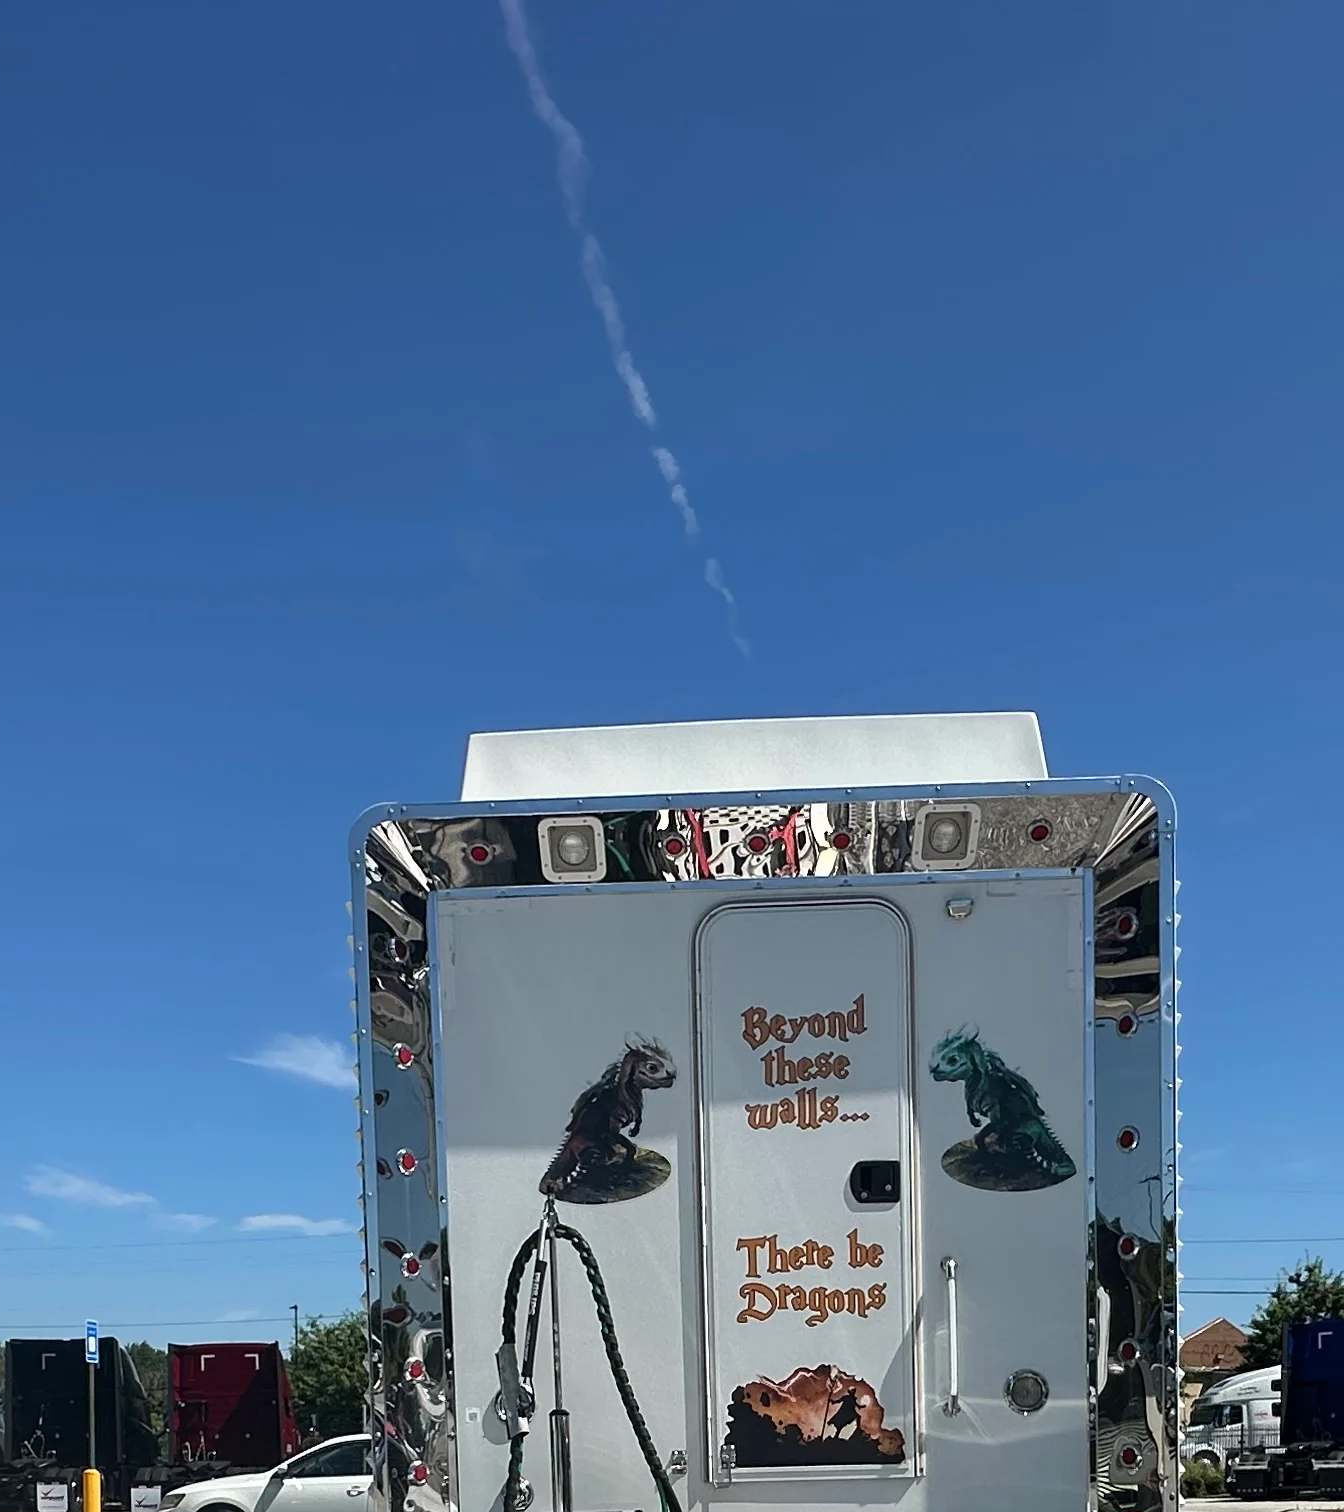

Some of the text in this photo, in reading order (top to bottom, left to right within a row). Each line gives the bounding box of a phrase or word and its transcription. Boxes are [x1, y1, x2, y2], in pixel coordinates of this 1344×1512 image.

[741, 993, 868, 1051] Beyond
[760, 1045, 851, 1088] these
[745, 1086, 870, 1130] walls...
[736, 1228, 885, 1278] There be
[736, 1282, 888, 1328] Dragons
